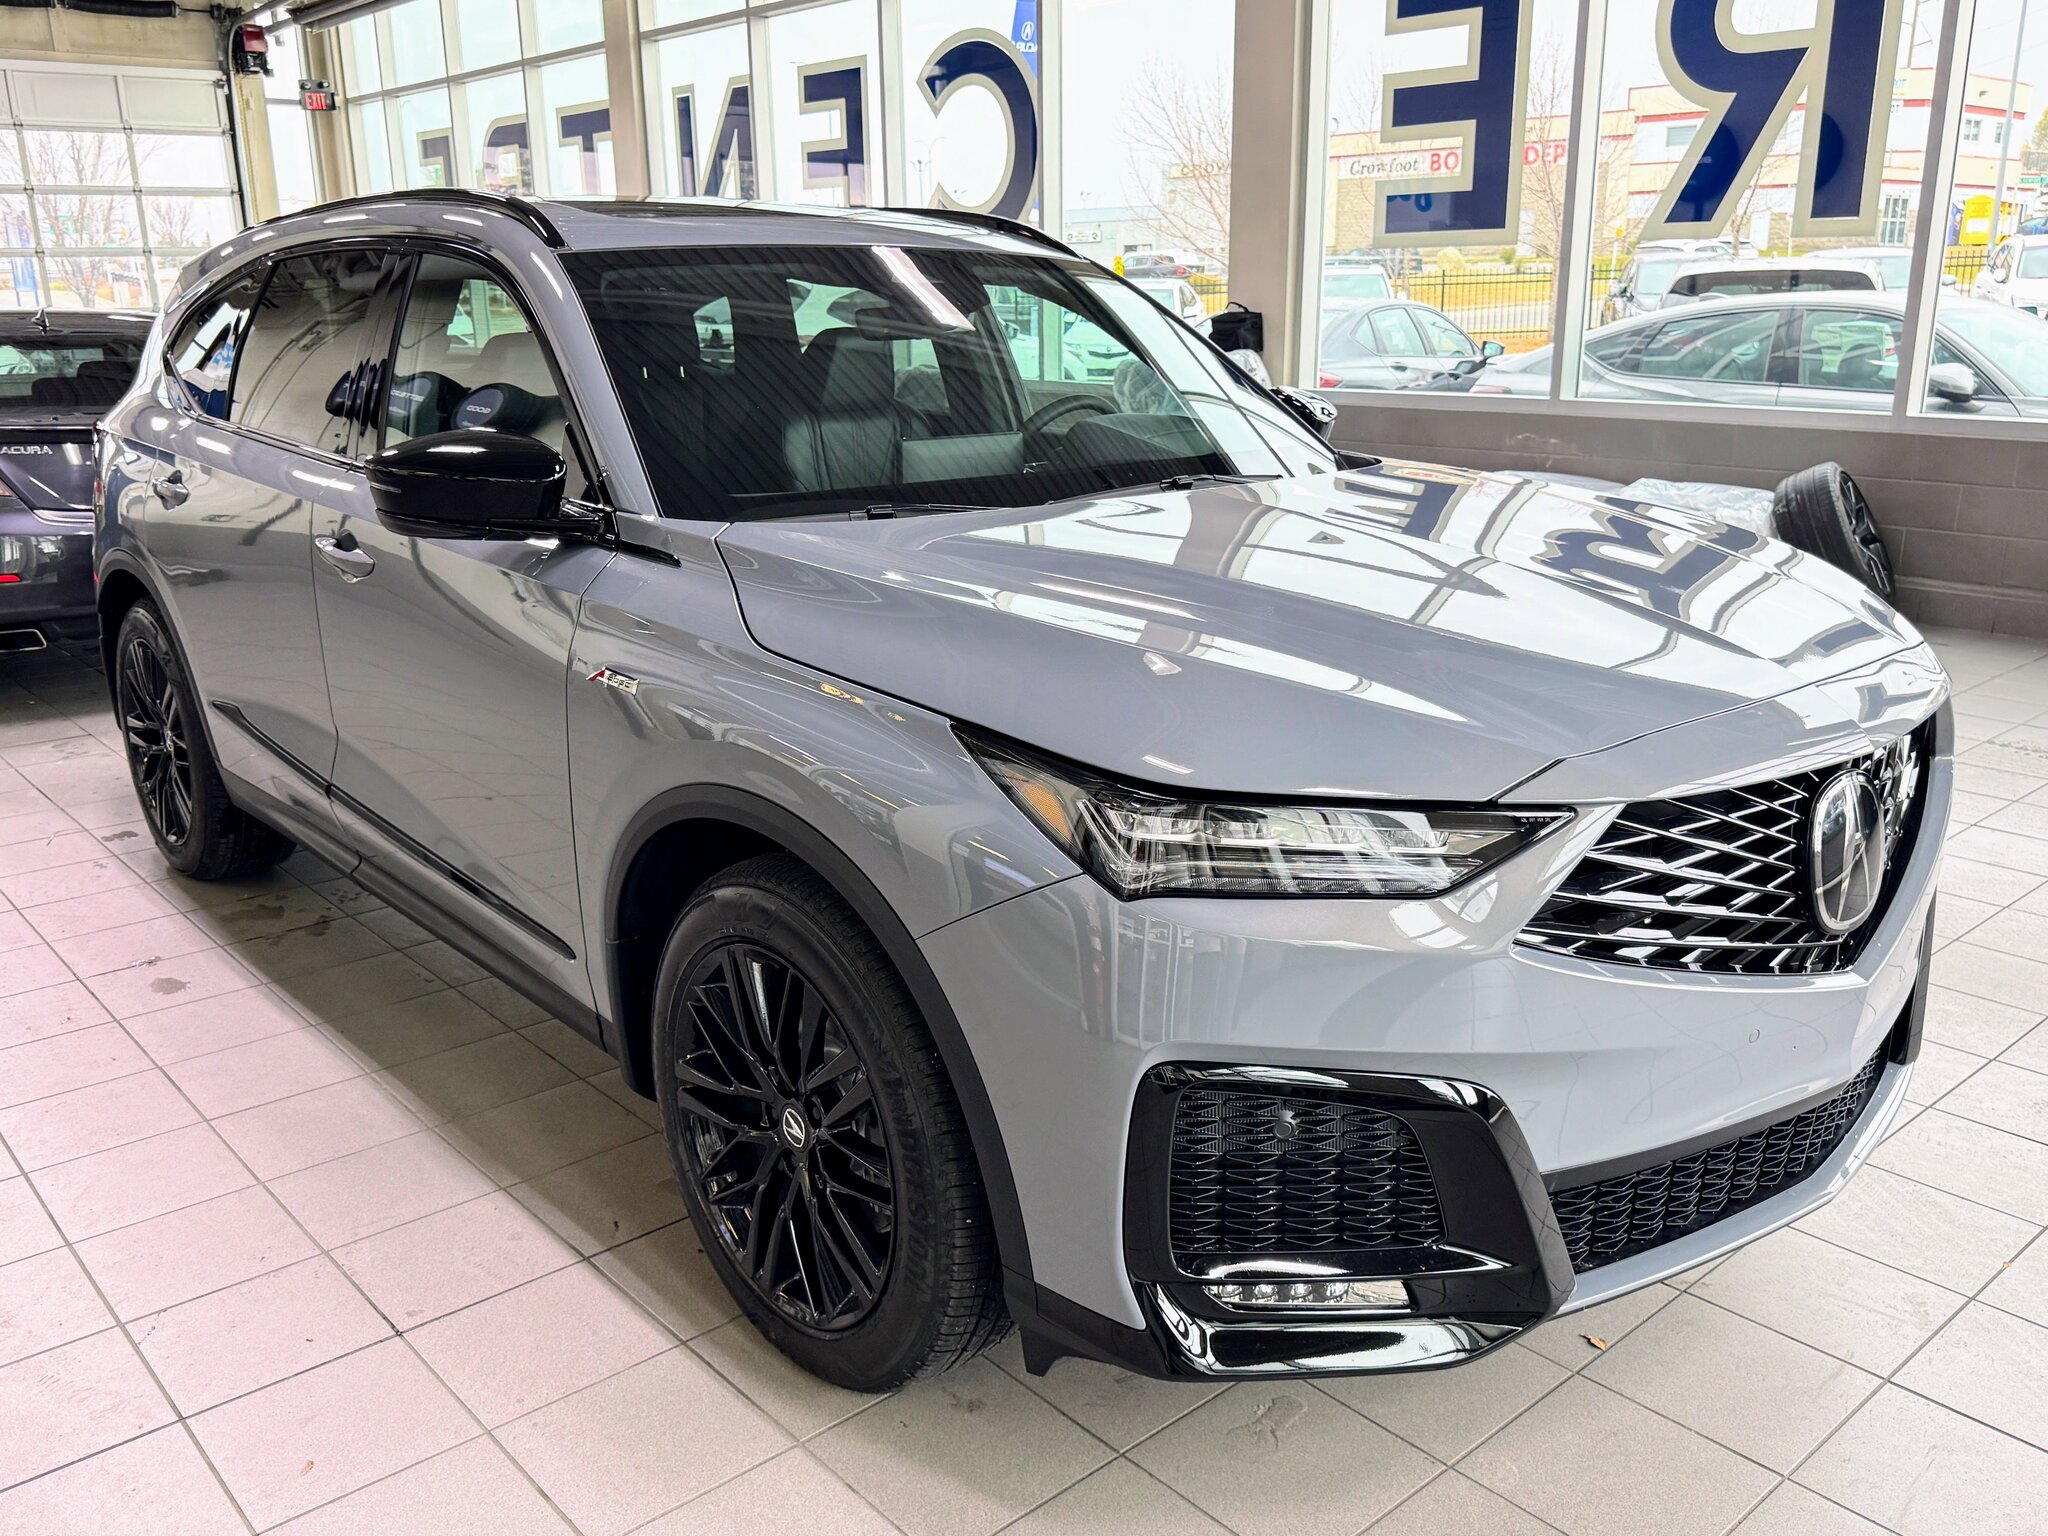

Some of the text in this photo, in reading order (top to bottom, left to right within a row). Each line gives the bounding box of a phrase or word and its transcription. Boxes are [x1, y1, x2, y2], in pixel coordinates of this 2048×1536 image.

[304, 92, 327, 110] EXIT
[1350, 157, 1420, 176] Crowfoot
[0, 445, 53, 455] ACURA
